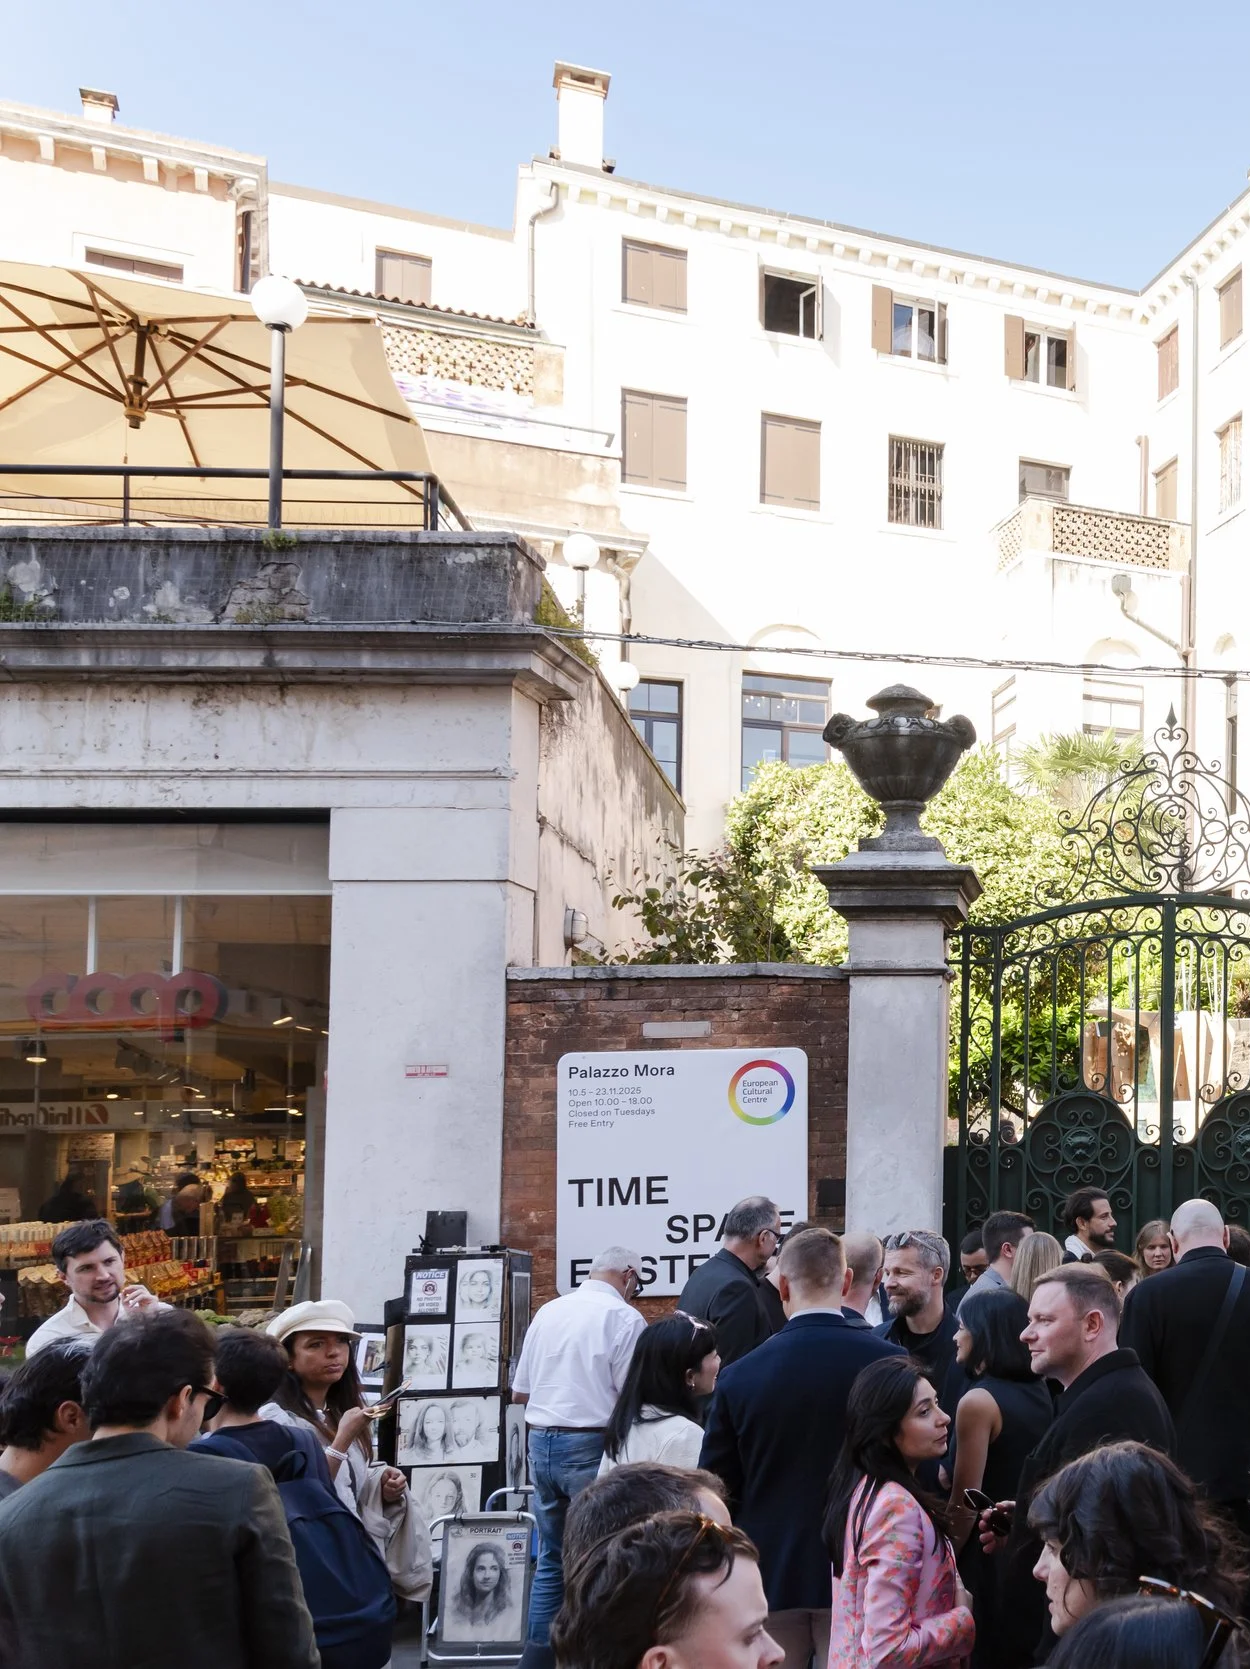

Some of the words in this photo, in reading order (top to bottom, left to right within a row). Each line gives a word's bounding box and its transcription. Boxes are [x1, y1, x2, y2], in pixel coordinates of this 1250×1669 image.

[568, 1066, 629, 1079] Palazzo
[634, 1064, 675, 1077] Mora
[742, 1080, 779, 1088] European
[568, 1088, 587, 1097] 10.5
[595, 1086, 642, 1096] 23.11.2025
[742, 1087, 773, 1095] Cultural
[568, 1099, 592, 1108] Open
[594, 1097, 620, 1106] 10.00
[628, 1096, 653, 1105] 18.00
[568, 1109, 599, 1117] Closed
[614, 1107, 656, 1117] Tuesdays
[568, 1120, 588, 1128] Free
[590, 1119, 615, 1128] Entry
[568, 1176, 669, 1207] TIME
[665, 1210, 795, 1244] SPE
[416, 1271, 446, 1279] NOTICE
